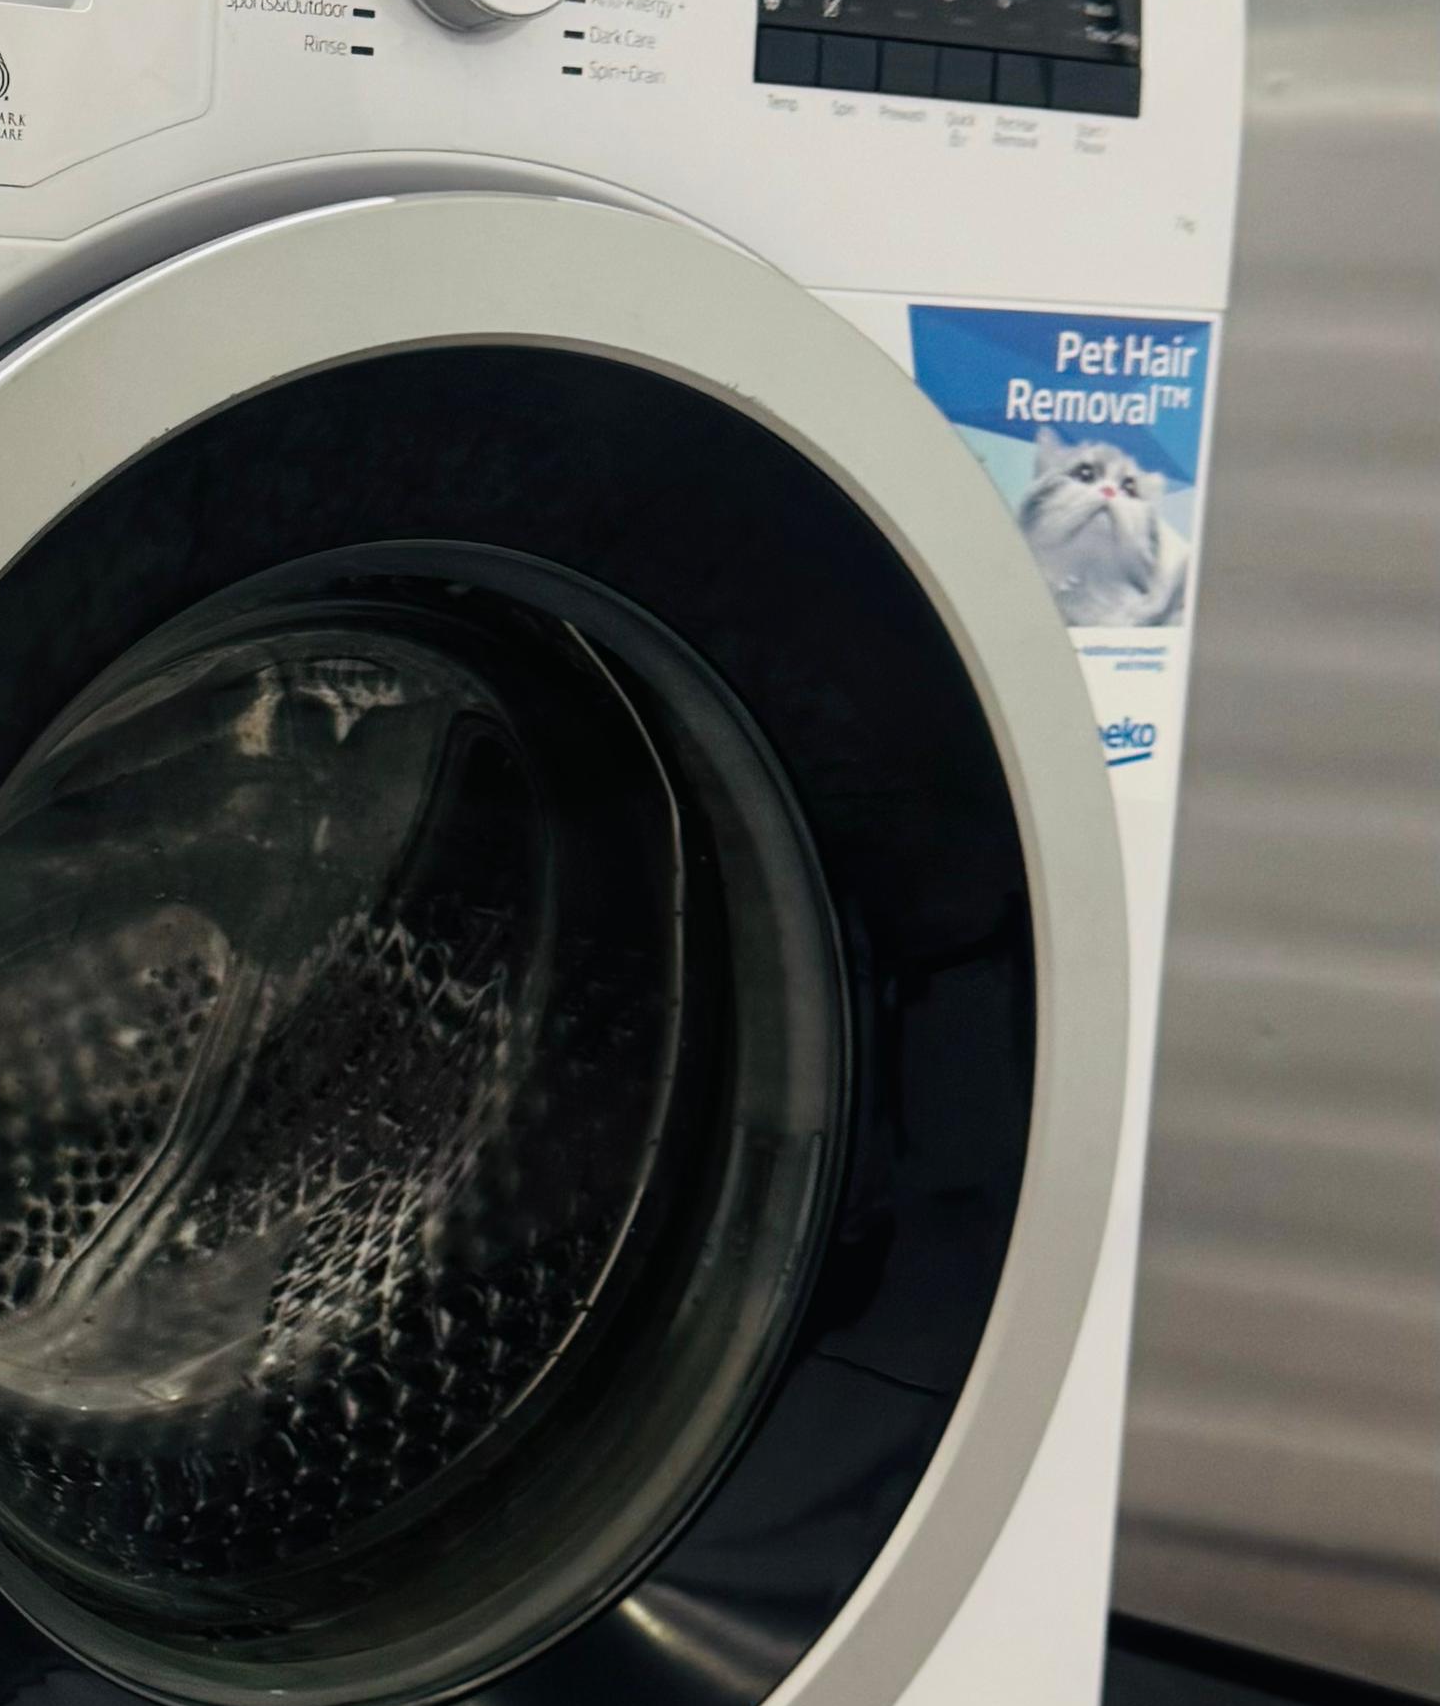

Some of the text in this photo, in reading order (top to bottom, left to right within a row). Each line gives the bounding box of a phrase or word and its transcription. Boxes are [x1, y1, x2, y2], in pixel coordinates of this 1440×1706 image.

[304, 35, 347, 56] Rinse
[1056, 331, 1198, 380] Pet Hair
